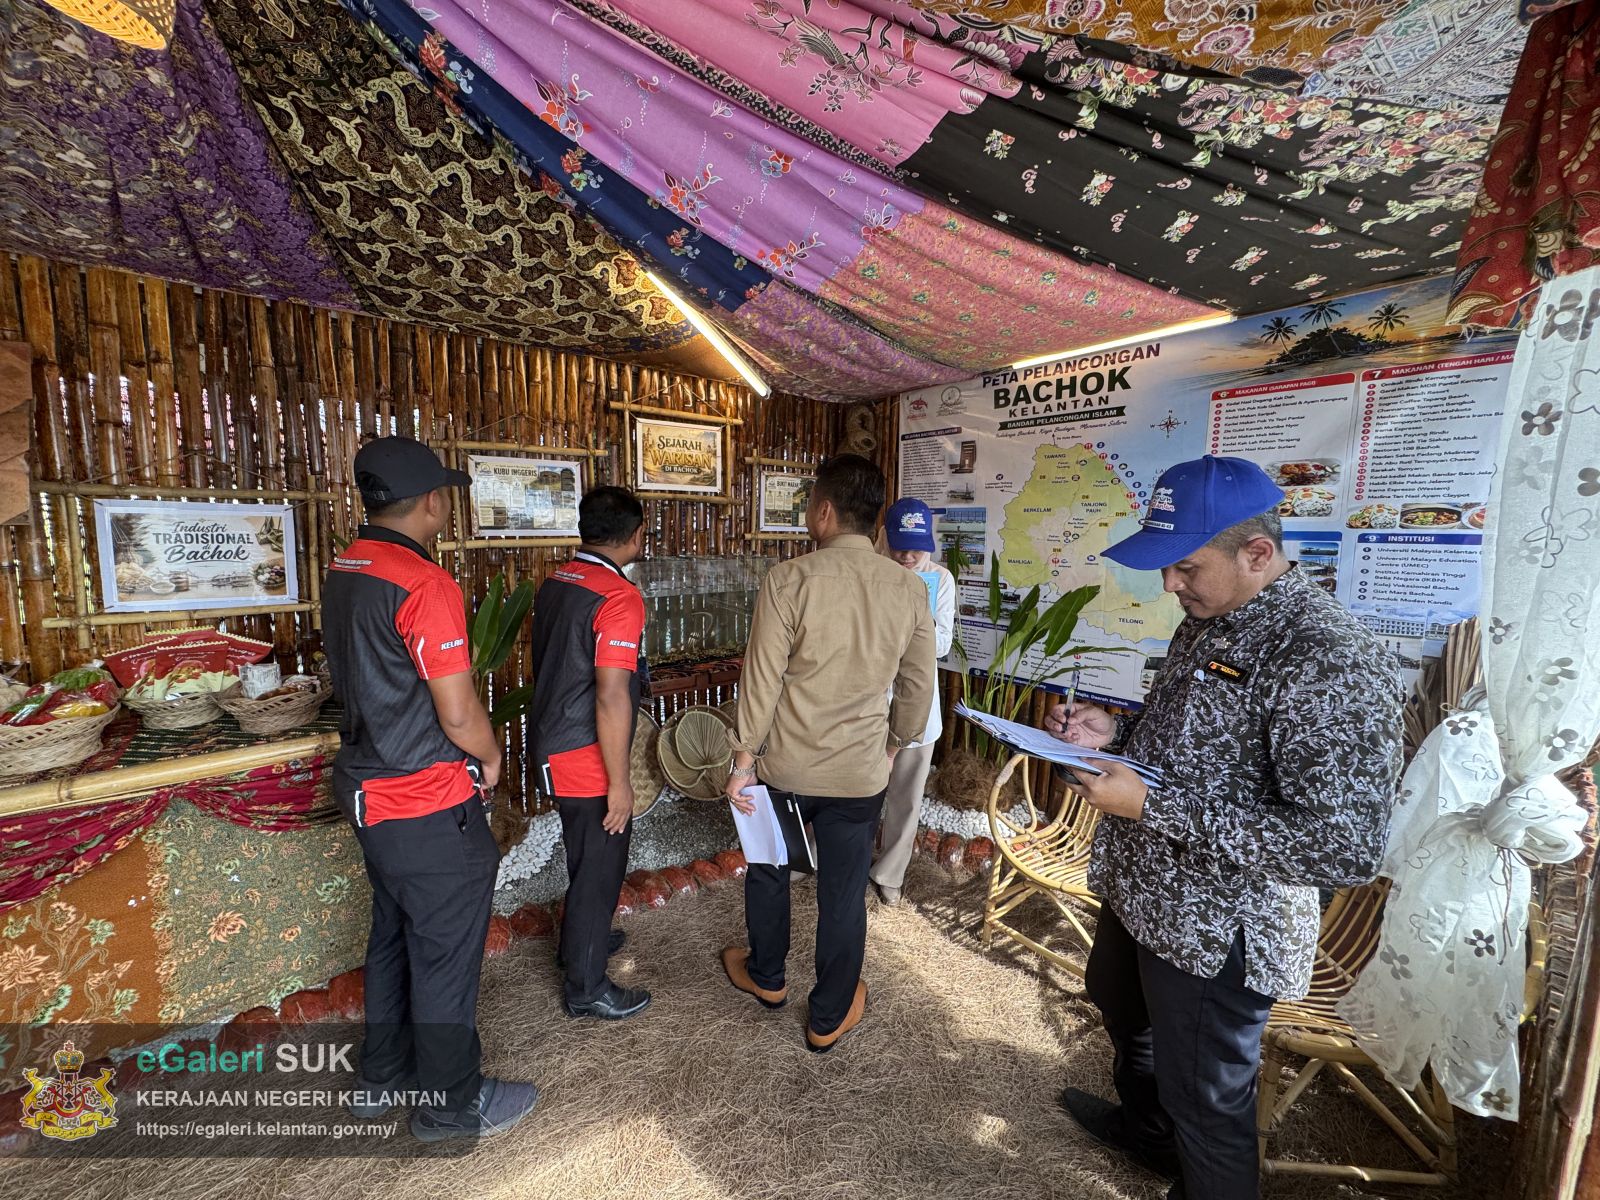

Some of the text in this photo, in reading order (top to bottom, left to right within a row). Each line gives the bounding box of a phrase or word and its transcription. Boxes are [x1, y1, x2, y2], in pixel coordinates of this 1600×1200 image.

[982, 343, 1161, 388] PETA PELANCONGAN
[1392, 364, 1435, 375] MAKANAN
[1438, 359, 1472, 369] (TENGAH
[994, 367, 1131, 408] BACHOK
[1235, 387, 1267, 395] MAKANAN
[1009, 396, 1110, 418] KELANTAN
[1037, 414, 1090, 424] PELANCONGAN
[1092, 410, 1116, 418] ISLAM
[657, 436, 701, 450] SEJARAH
[650, 450, 713, 469] WARISAN
[172, 521, 227, 534] Industri
[152, 532, 254, 545] TRADISIONAL
[164, 544, 251, 563] Bachok
[1118, 617, 1144, 625] TELONG
